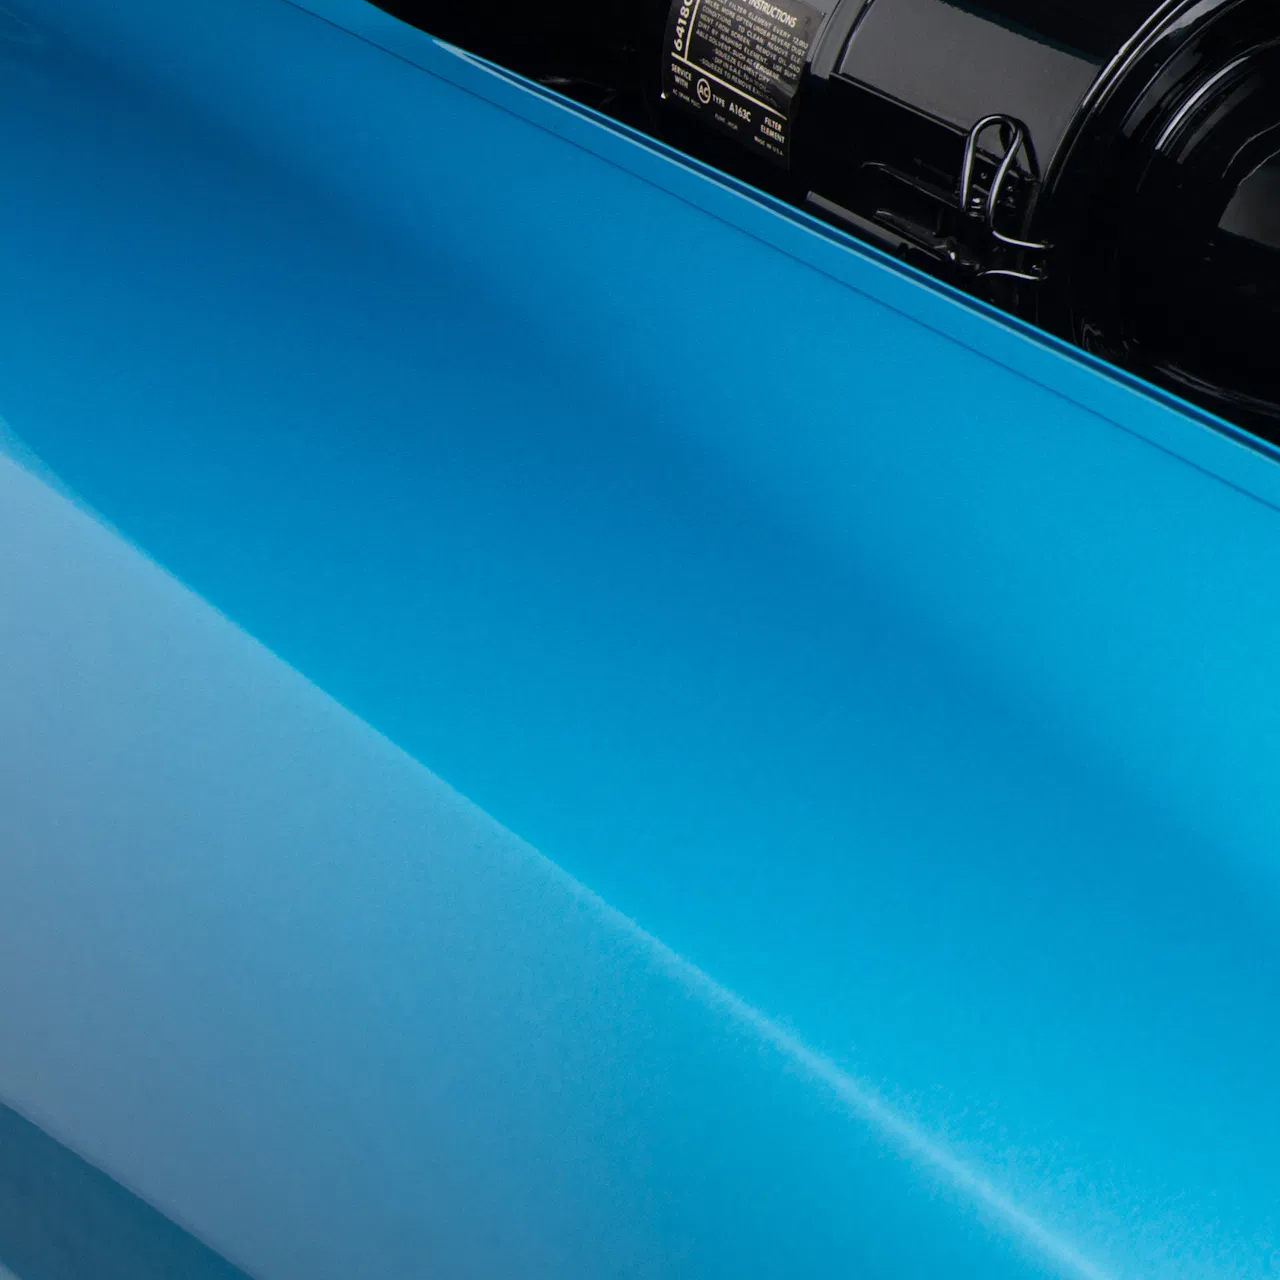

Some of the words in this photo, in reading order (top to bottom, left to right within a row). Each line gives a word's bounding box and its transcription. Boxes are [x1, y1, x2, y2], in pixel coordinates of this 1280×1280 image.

[728, 1, 747, 15] FILTER
[748, 12, 771, 28] ELEMENT
[773, 26, 790, 39] EVERY
[736, 15, 753, 27] OFTEN
[791, 45, 805, 56] DUST
[755, 44, 776, 60] REMOVE
[789, 63, 800, 73] AND
[671, 63, 692, 81] SERVICE
[674, 75, 689, 90] WITH
[712, 94, 726, 108] TYPE
[729, 102, 752, 123] A163C
[760, 125, 785, 144] ELEMENT
[764, 116, 783, 132] FILTER
